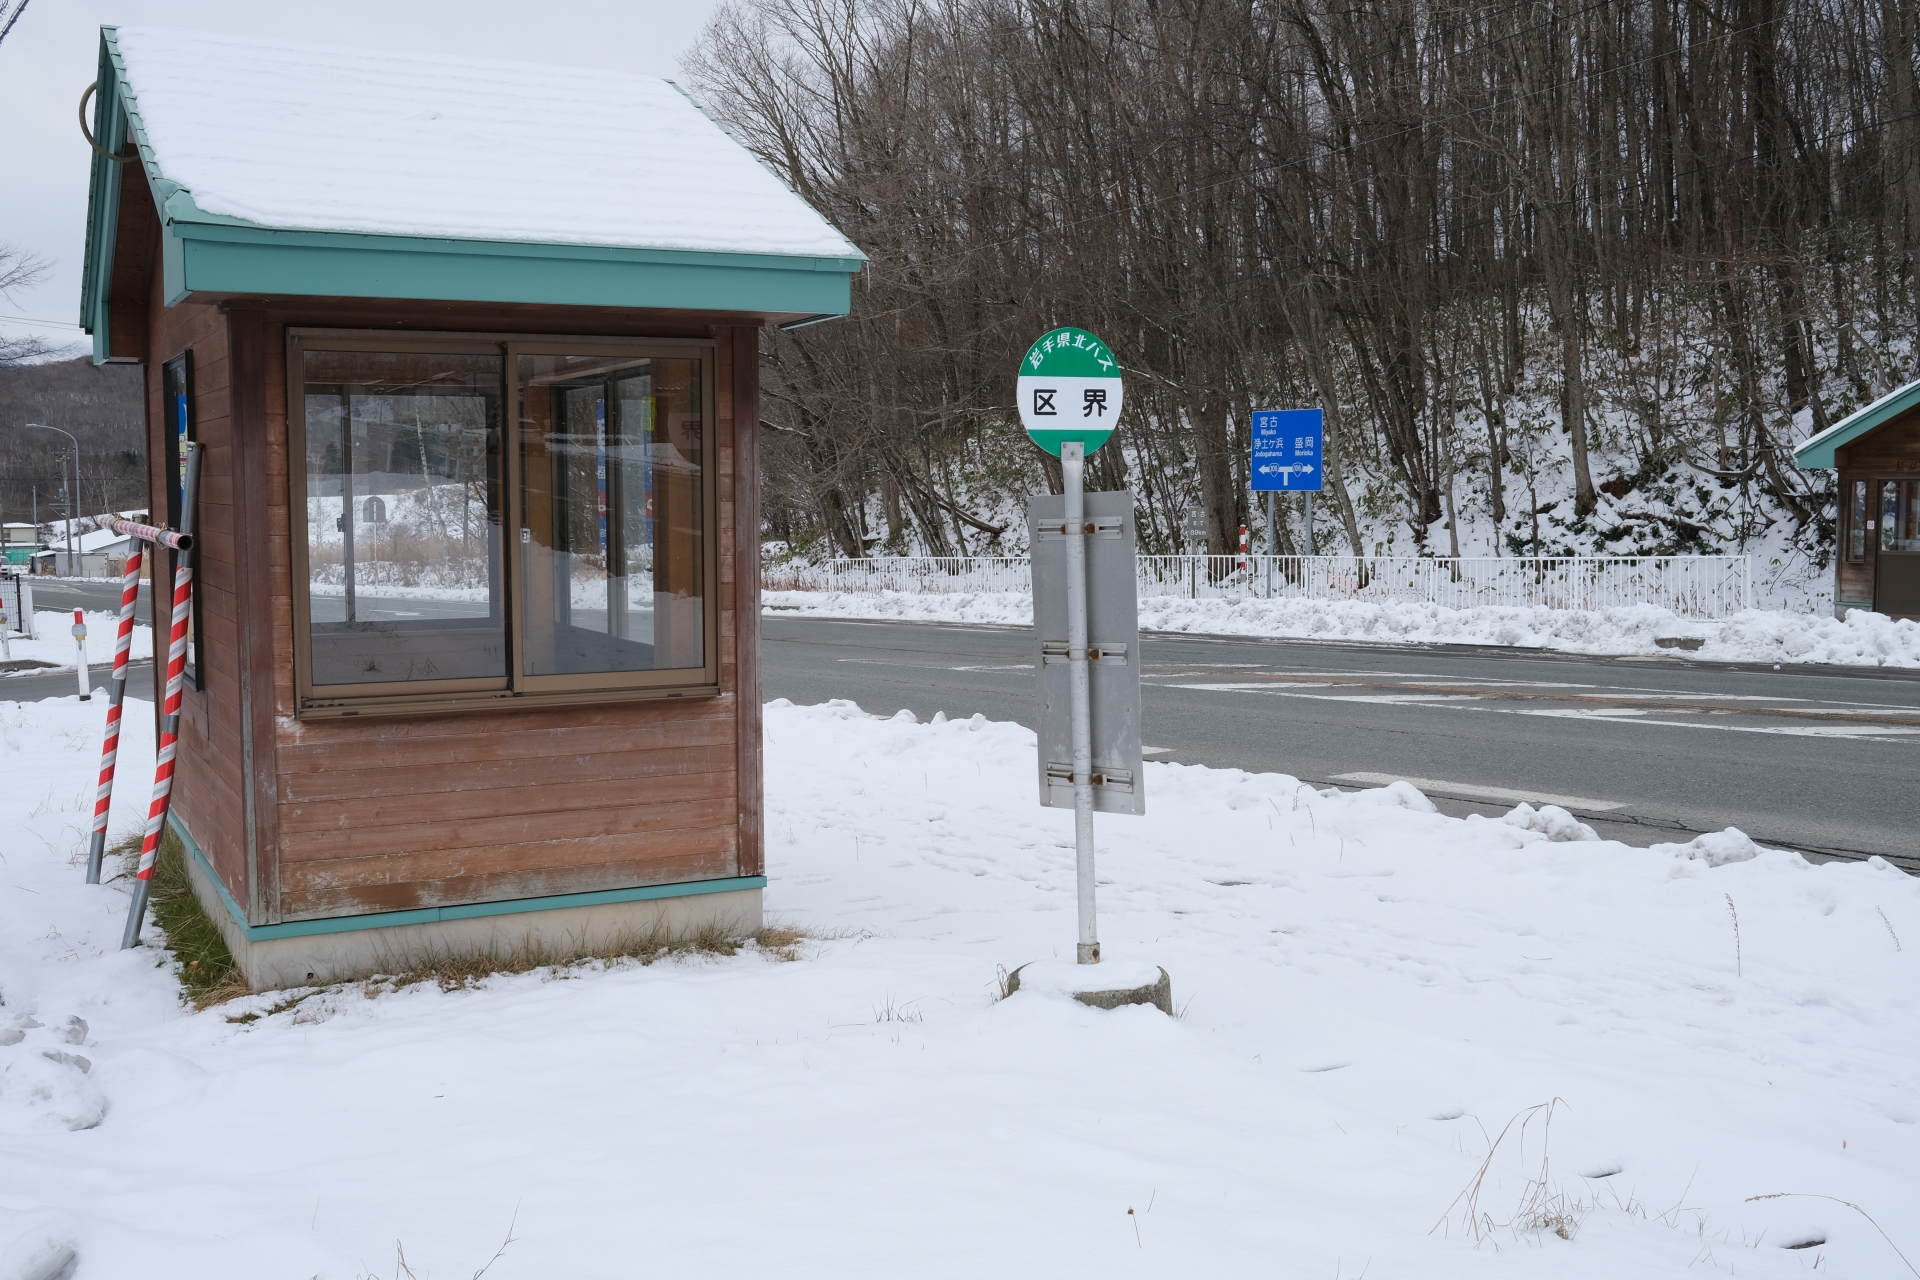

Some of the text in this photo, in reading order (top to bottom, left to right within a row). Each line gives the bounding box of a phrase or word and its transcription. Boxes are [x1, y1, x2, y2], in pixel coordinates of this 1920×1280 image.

[1029, 332, 1114, 372] 岩手県北バス
[1034, 389, 1108, 417] 区界
[1260, 416, 1278, 427] 宮古
[1295, 437, 1313, 448] 盛岡
[1191, 510, 1206, 518] 宮古
